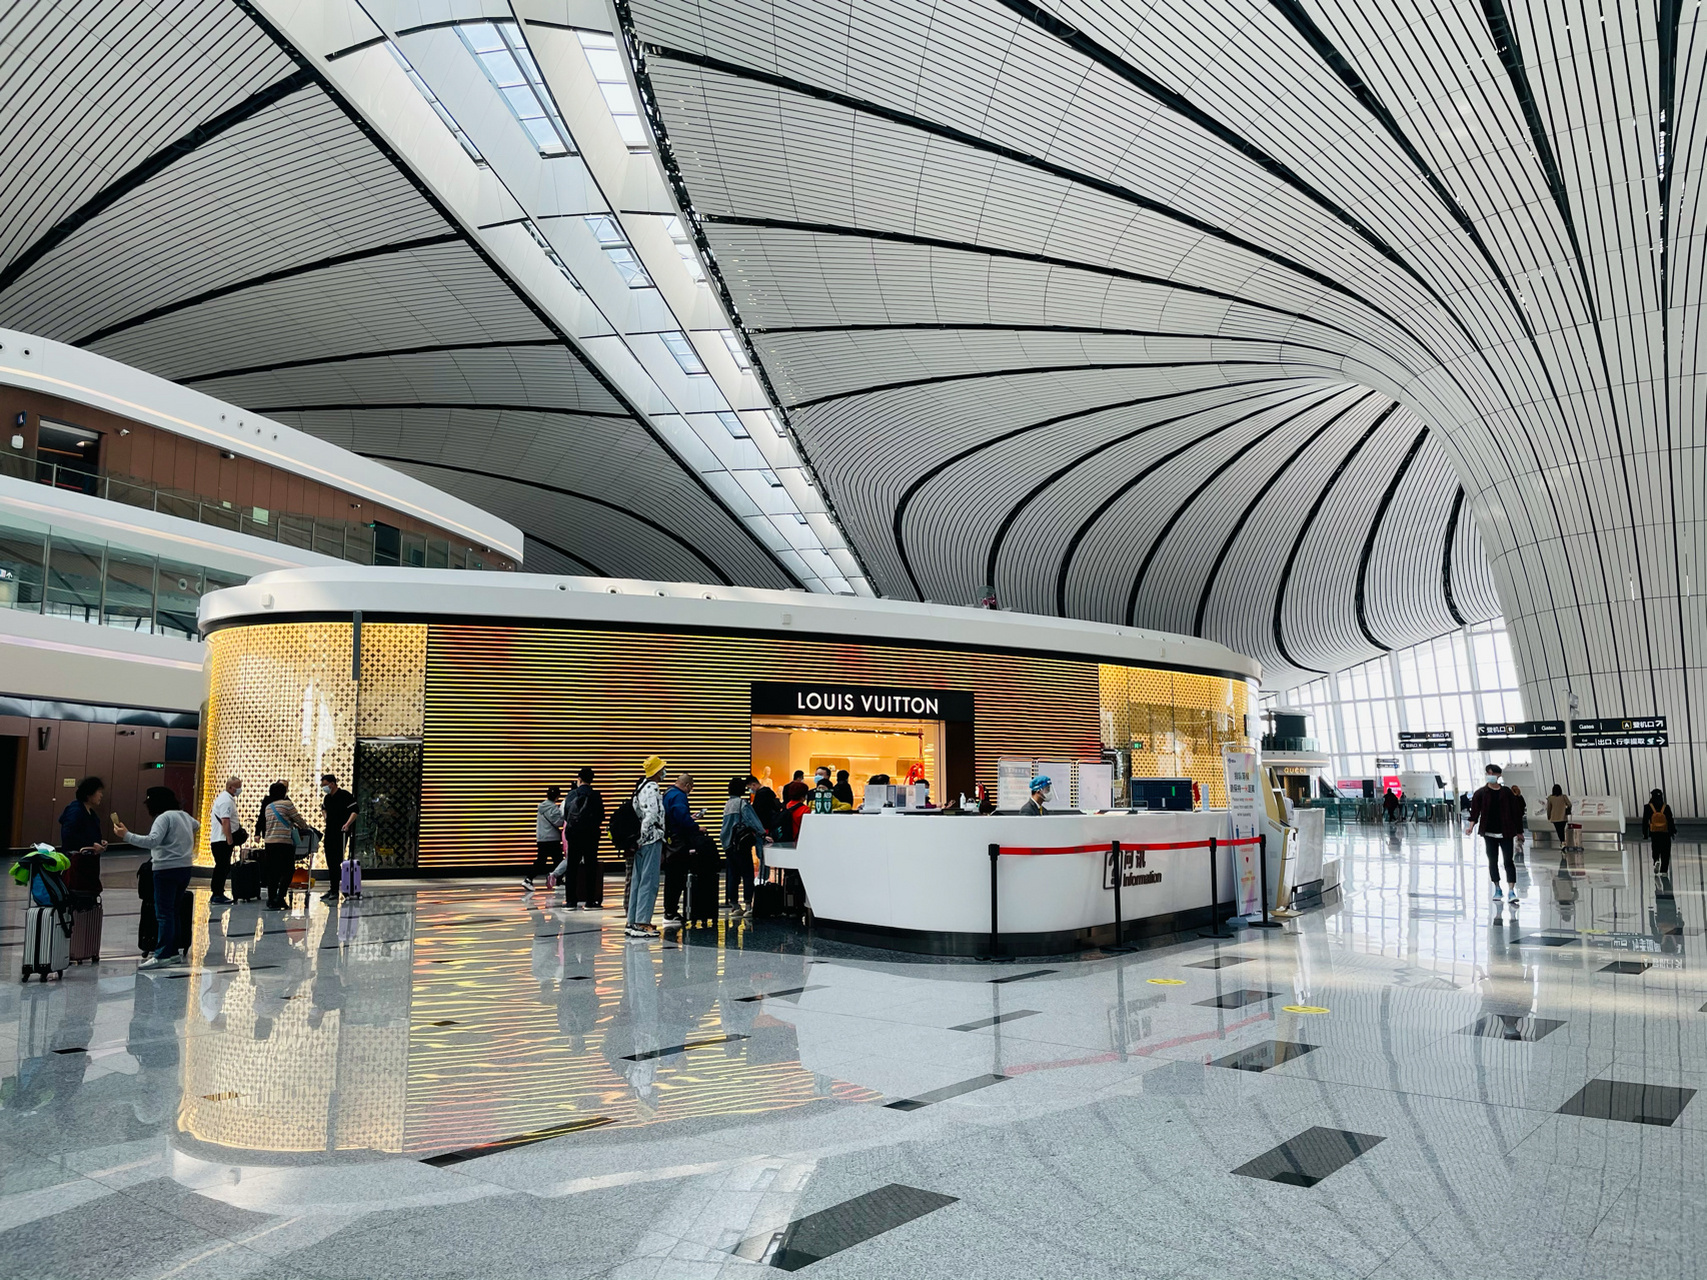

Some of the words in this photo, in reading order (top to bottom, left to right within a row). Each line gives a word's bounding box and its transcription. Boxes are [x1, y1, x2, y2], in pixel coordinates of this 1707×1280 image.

[797, 691, 854, 712] LOUIS
[861, 694, 939, 715] VUITTON
[1632, 721, 1655, 729] 登机口
[1283, 766, 1307, 774] GUCCI
[1123, 870, 1162, 887] Information
